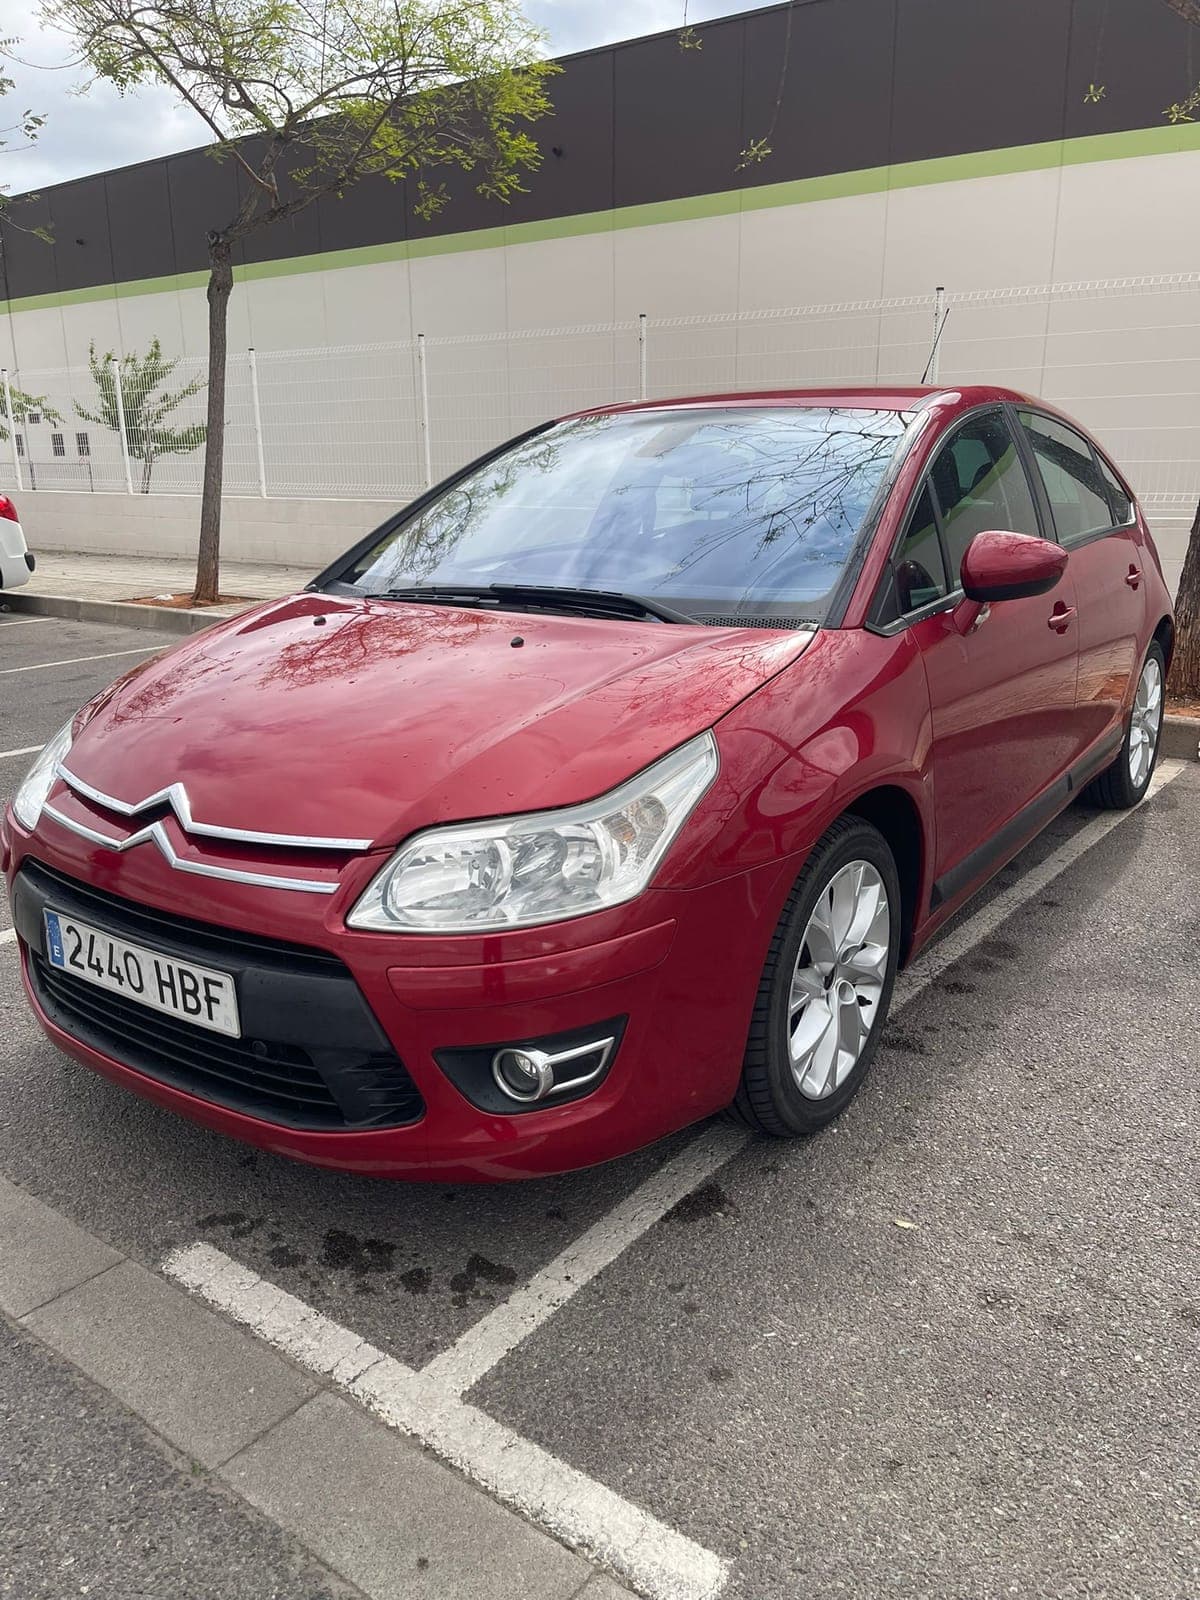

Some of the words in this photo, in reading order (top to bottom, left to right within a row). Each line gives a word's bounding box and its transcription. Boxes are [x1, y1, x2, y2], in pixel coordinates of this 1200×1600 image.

[53, 945, 61, 957] E
[66, 925, 144, 993] 2440
[154, 960, 223, 1021] HBF
